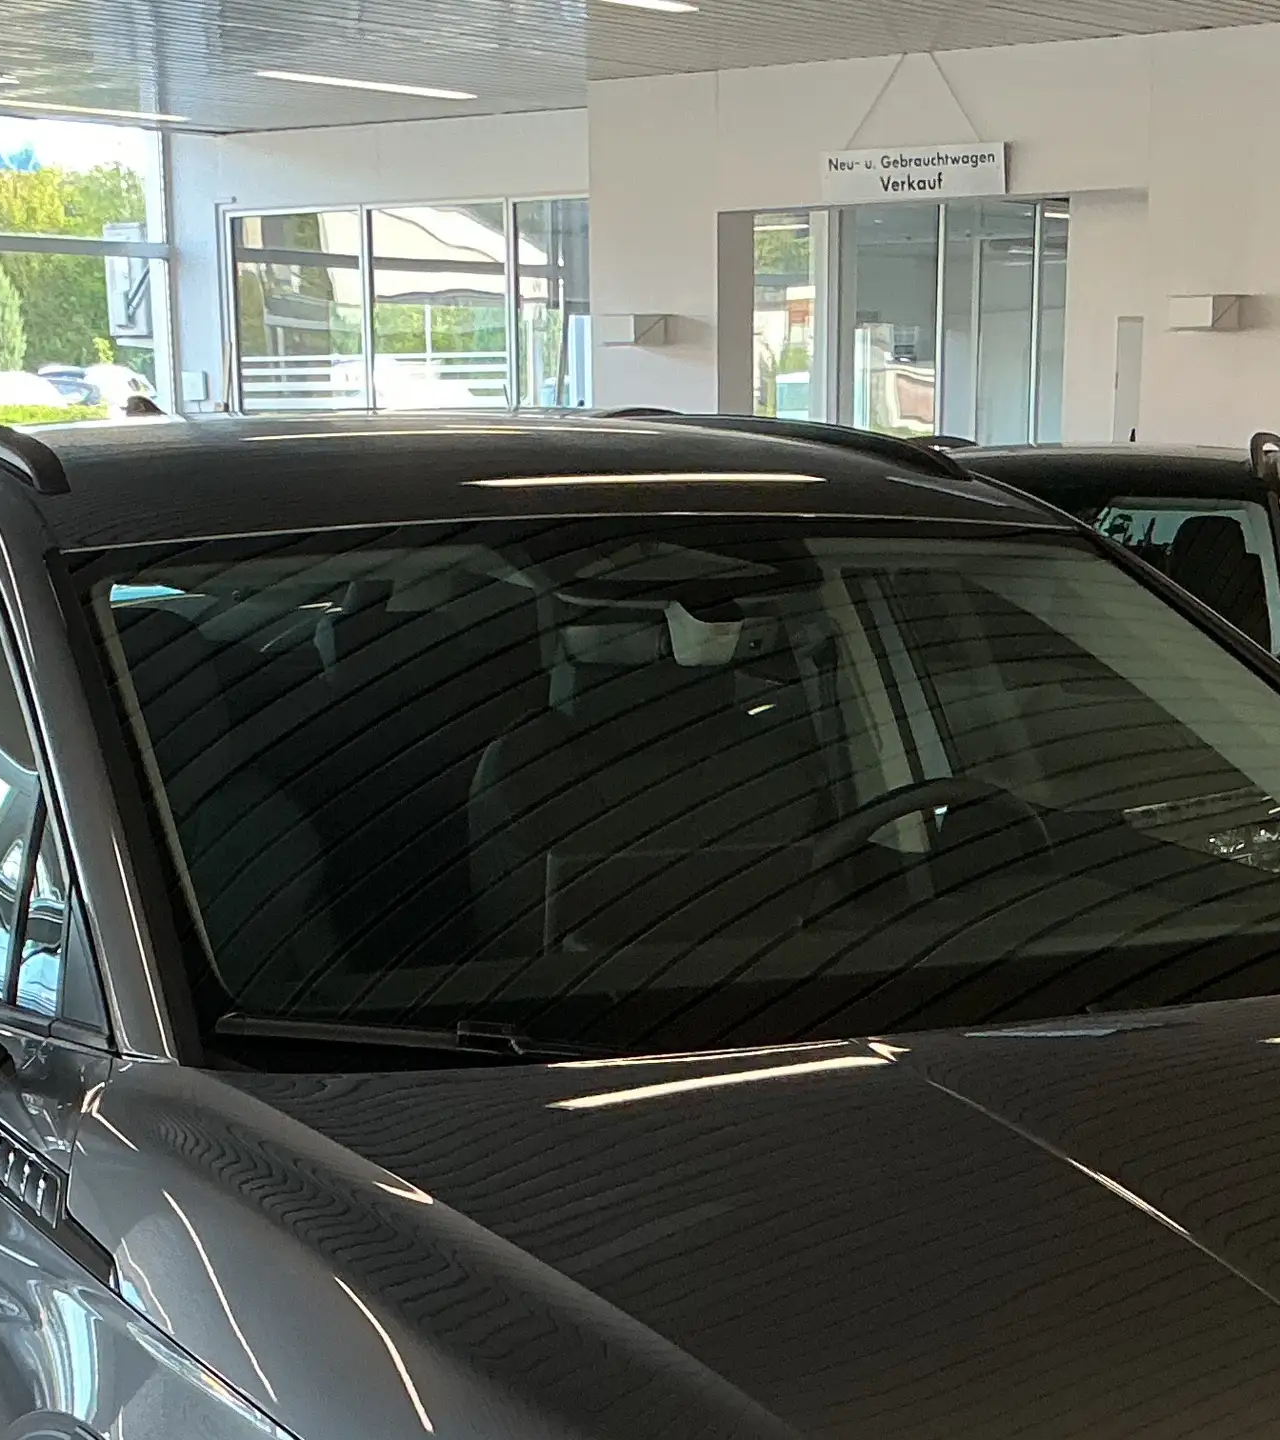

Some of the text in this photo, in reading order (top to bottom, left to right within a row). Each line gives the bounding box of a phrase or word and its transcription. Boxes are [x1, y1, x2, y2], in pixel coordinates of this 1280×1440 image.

[828, 152, 995, 171] Neu- u. Gebrauchtwagen
[880, 172, 943, 192] Verkauf
